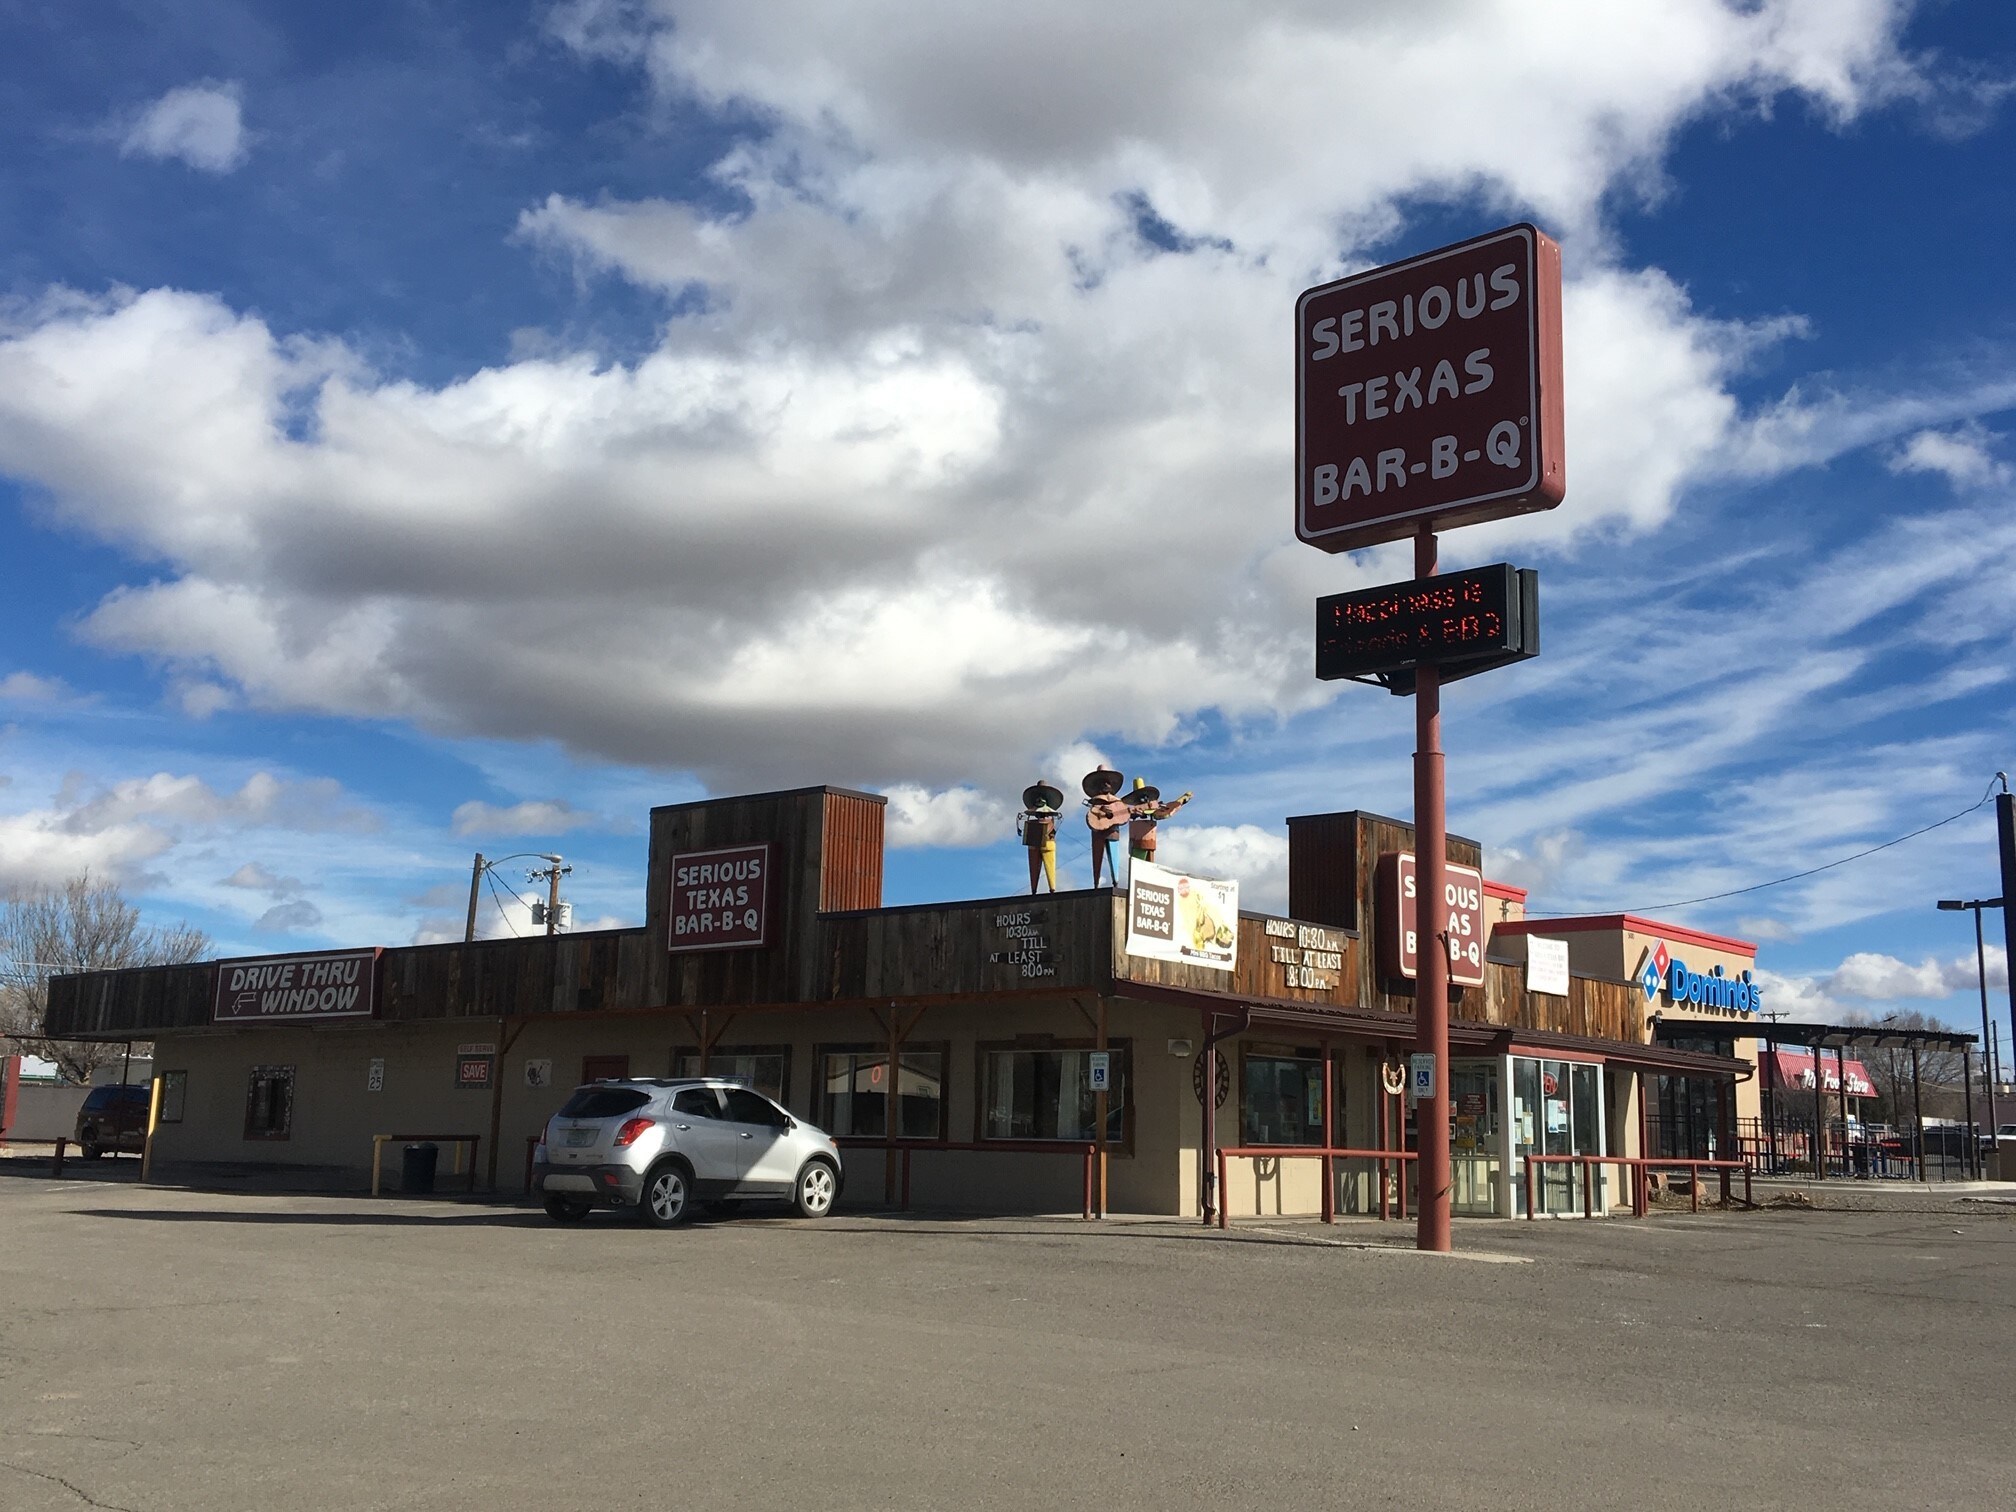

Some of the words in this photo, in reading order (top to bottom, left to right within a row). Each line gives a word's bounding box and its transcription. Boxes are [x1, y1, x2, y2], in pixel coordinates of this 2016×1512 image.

[1312, 263, 1520, 361] SERIOUS
[1338, 348, 1494, 425] TEXAS
[677, 859, 761, 887] SERIOUS
[686, 886, 749, 911] TEXAS
[1136, 887, 1170, 905] SERIOUS
[1404, 875, 1479, 911] SOUS
[675, 908, 758, 935] BAR-B-Q
[996, 912, 1031, 927] HOURS
[1140, 903, 1165, 918] TEXAS
[1021, 937, 1047, 949] TILL
[1265, 919, 1295, 938] HOURS
[1298, 925, 1325, 949] 10:30
[989, 952, 1000, 963] AT
[1008, 950, 1042, 964] LEAST
[1271, 945, 1298, 964] TILL
[1302, 950, 1315, 967] AT
[1317, 952, 1342, 969] LEAST
[230, 964, 296, 991] DRIVE
[301, 960, 361, 986] THRU
[1288, 965, 1314, 989] 8:00
[1671, 958, 1761, 1013] Domino's
[261, 986, 359, 1013] WINDOW
[370, 1076, 382, 1089] 25
[463, 1064, 486, 1079] SAVE
